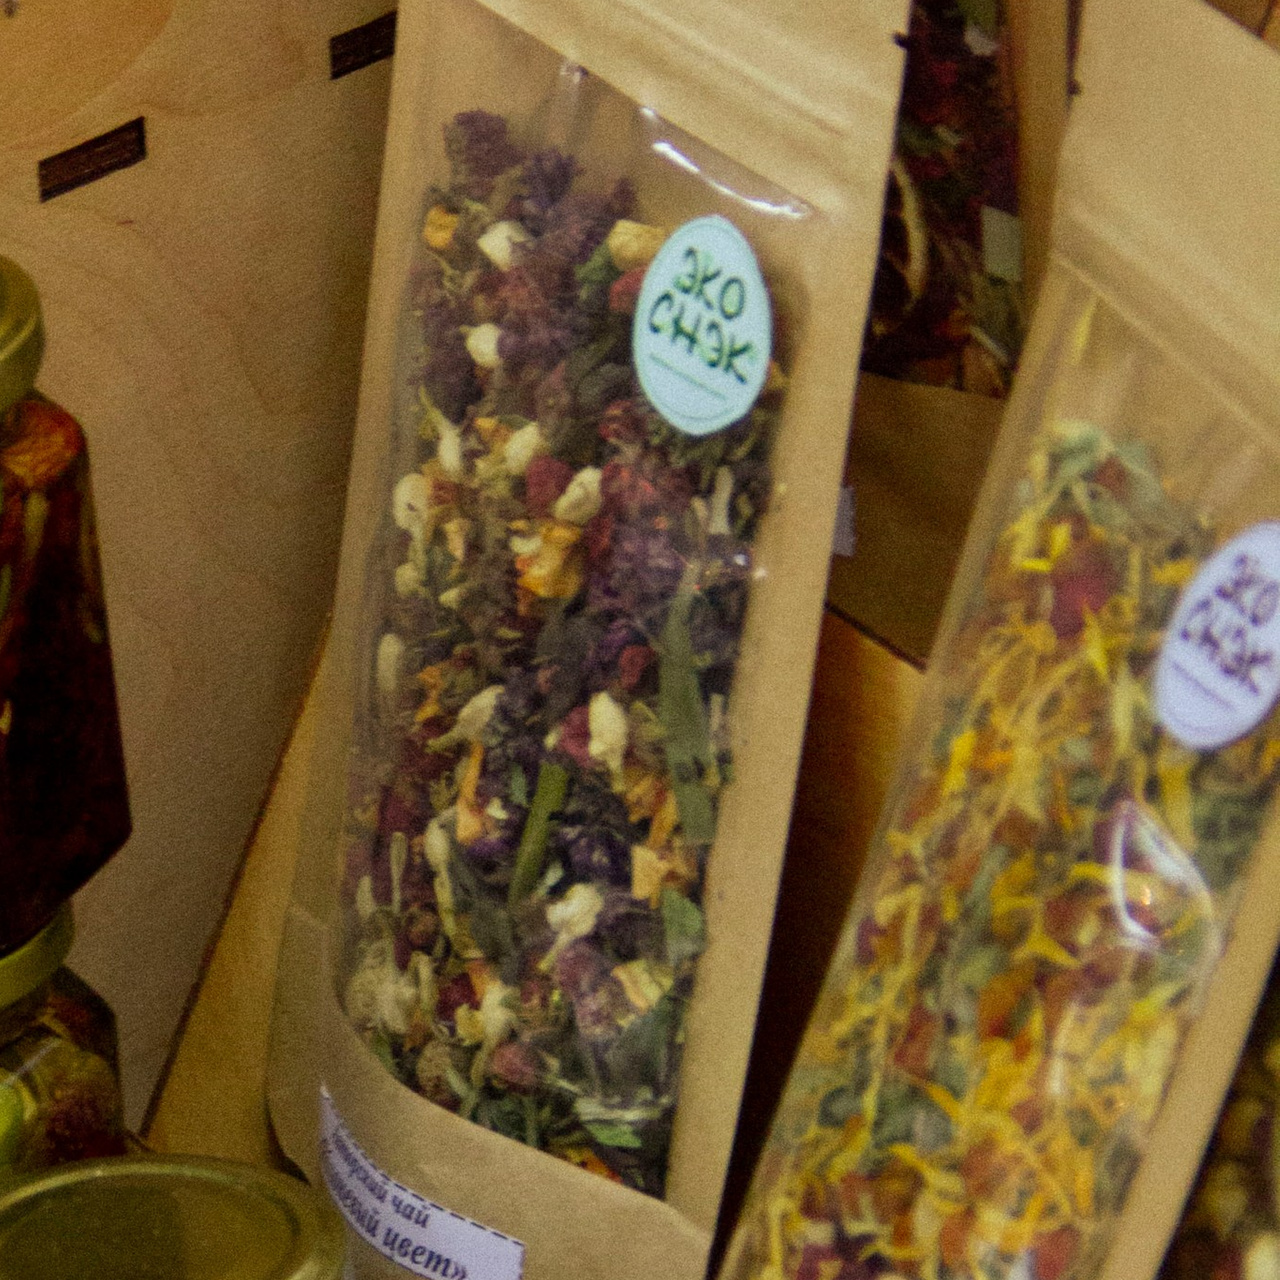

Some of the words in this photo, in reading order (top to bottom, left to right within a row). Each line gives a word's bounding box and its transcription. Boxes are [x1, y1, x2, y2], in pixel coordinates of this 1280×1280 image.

[673, 246, 746, 321] ЭКО
[647, 289, 758, 386] СНЭК
[1214, 551, 1280, 629] ЭКО
[1179, 596, 1275, 698] СНЭК
[391, 1193, 432, 1229] чай
